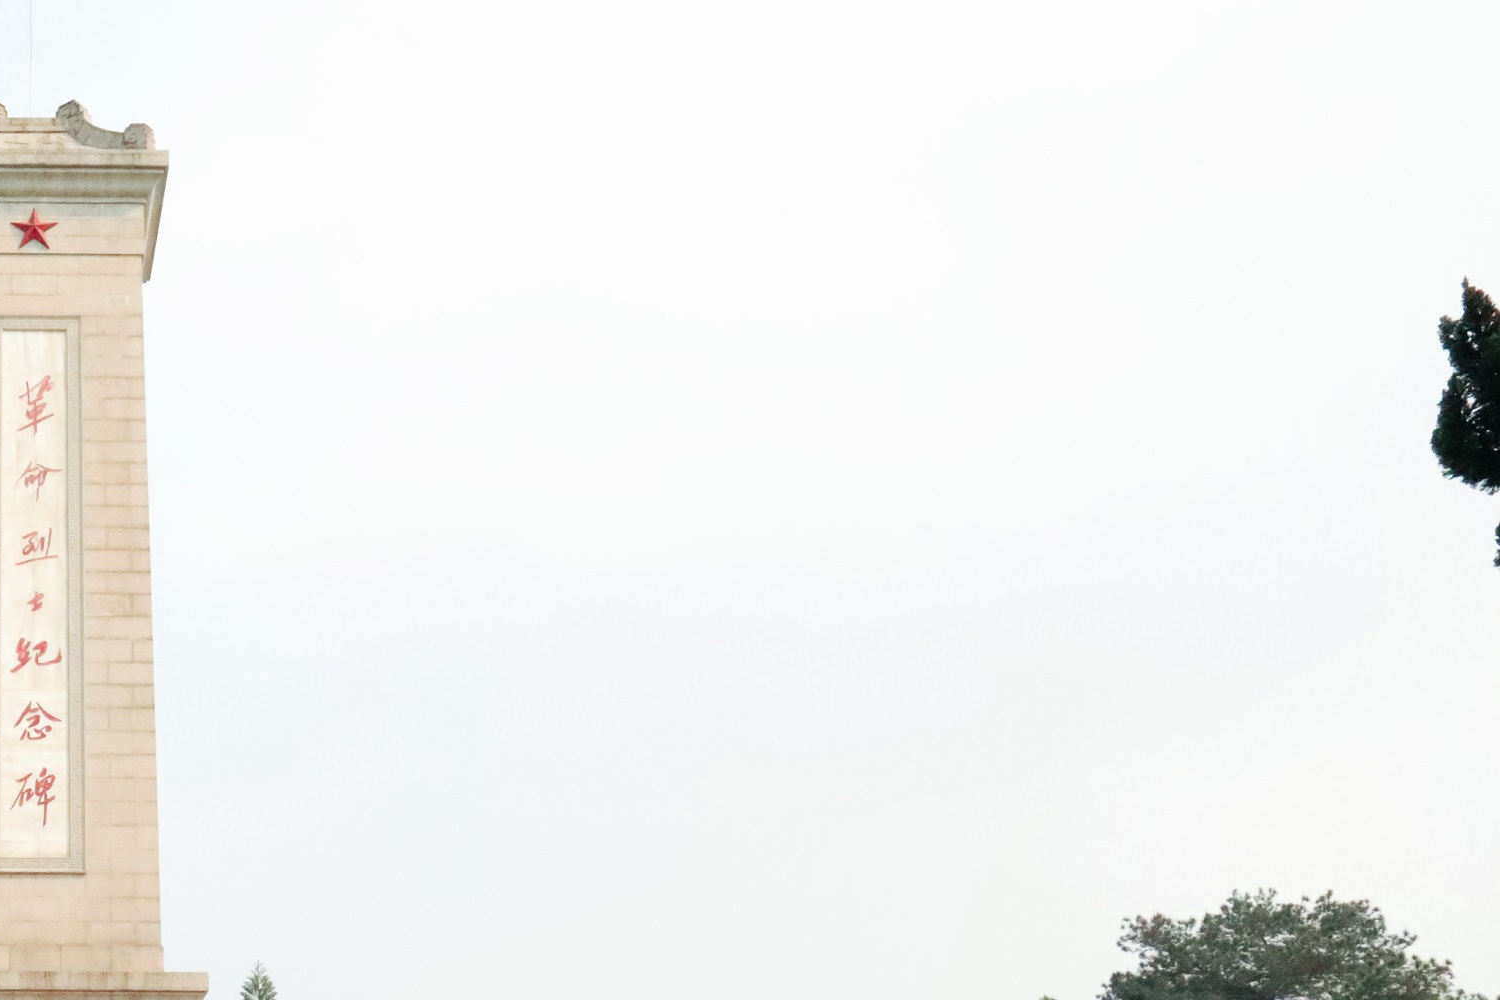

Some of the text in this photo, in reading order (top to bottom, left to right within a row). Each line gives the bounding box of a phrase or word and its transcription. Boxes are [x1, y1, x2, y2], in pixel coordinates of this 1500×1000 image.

[10, 375, 62, 826] 革命烈士纪念碑
